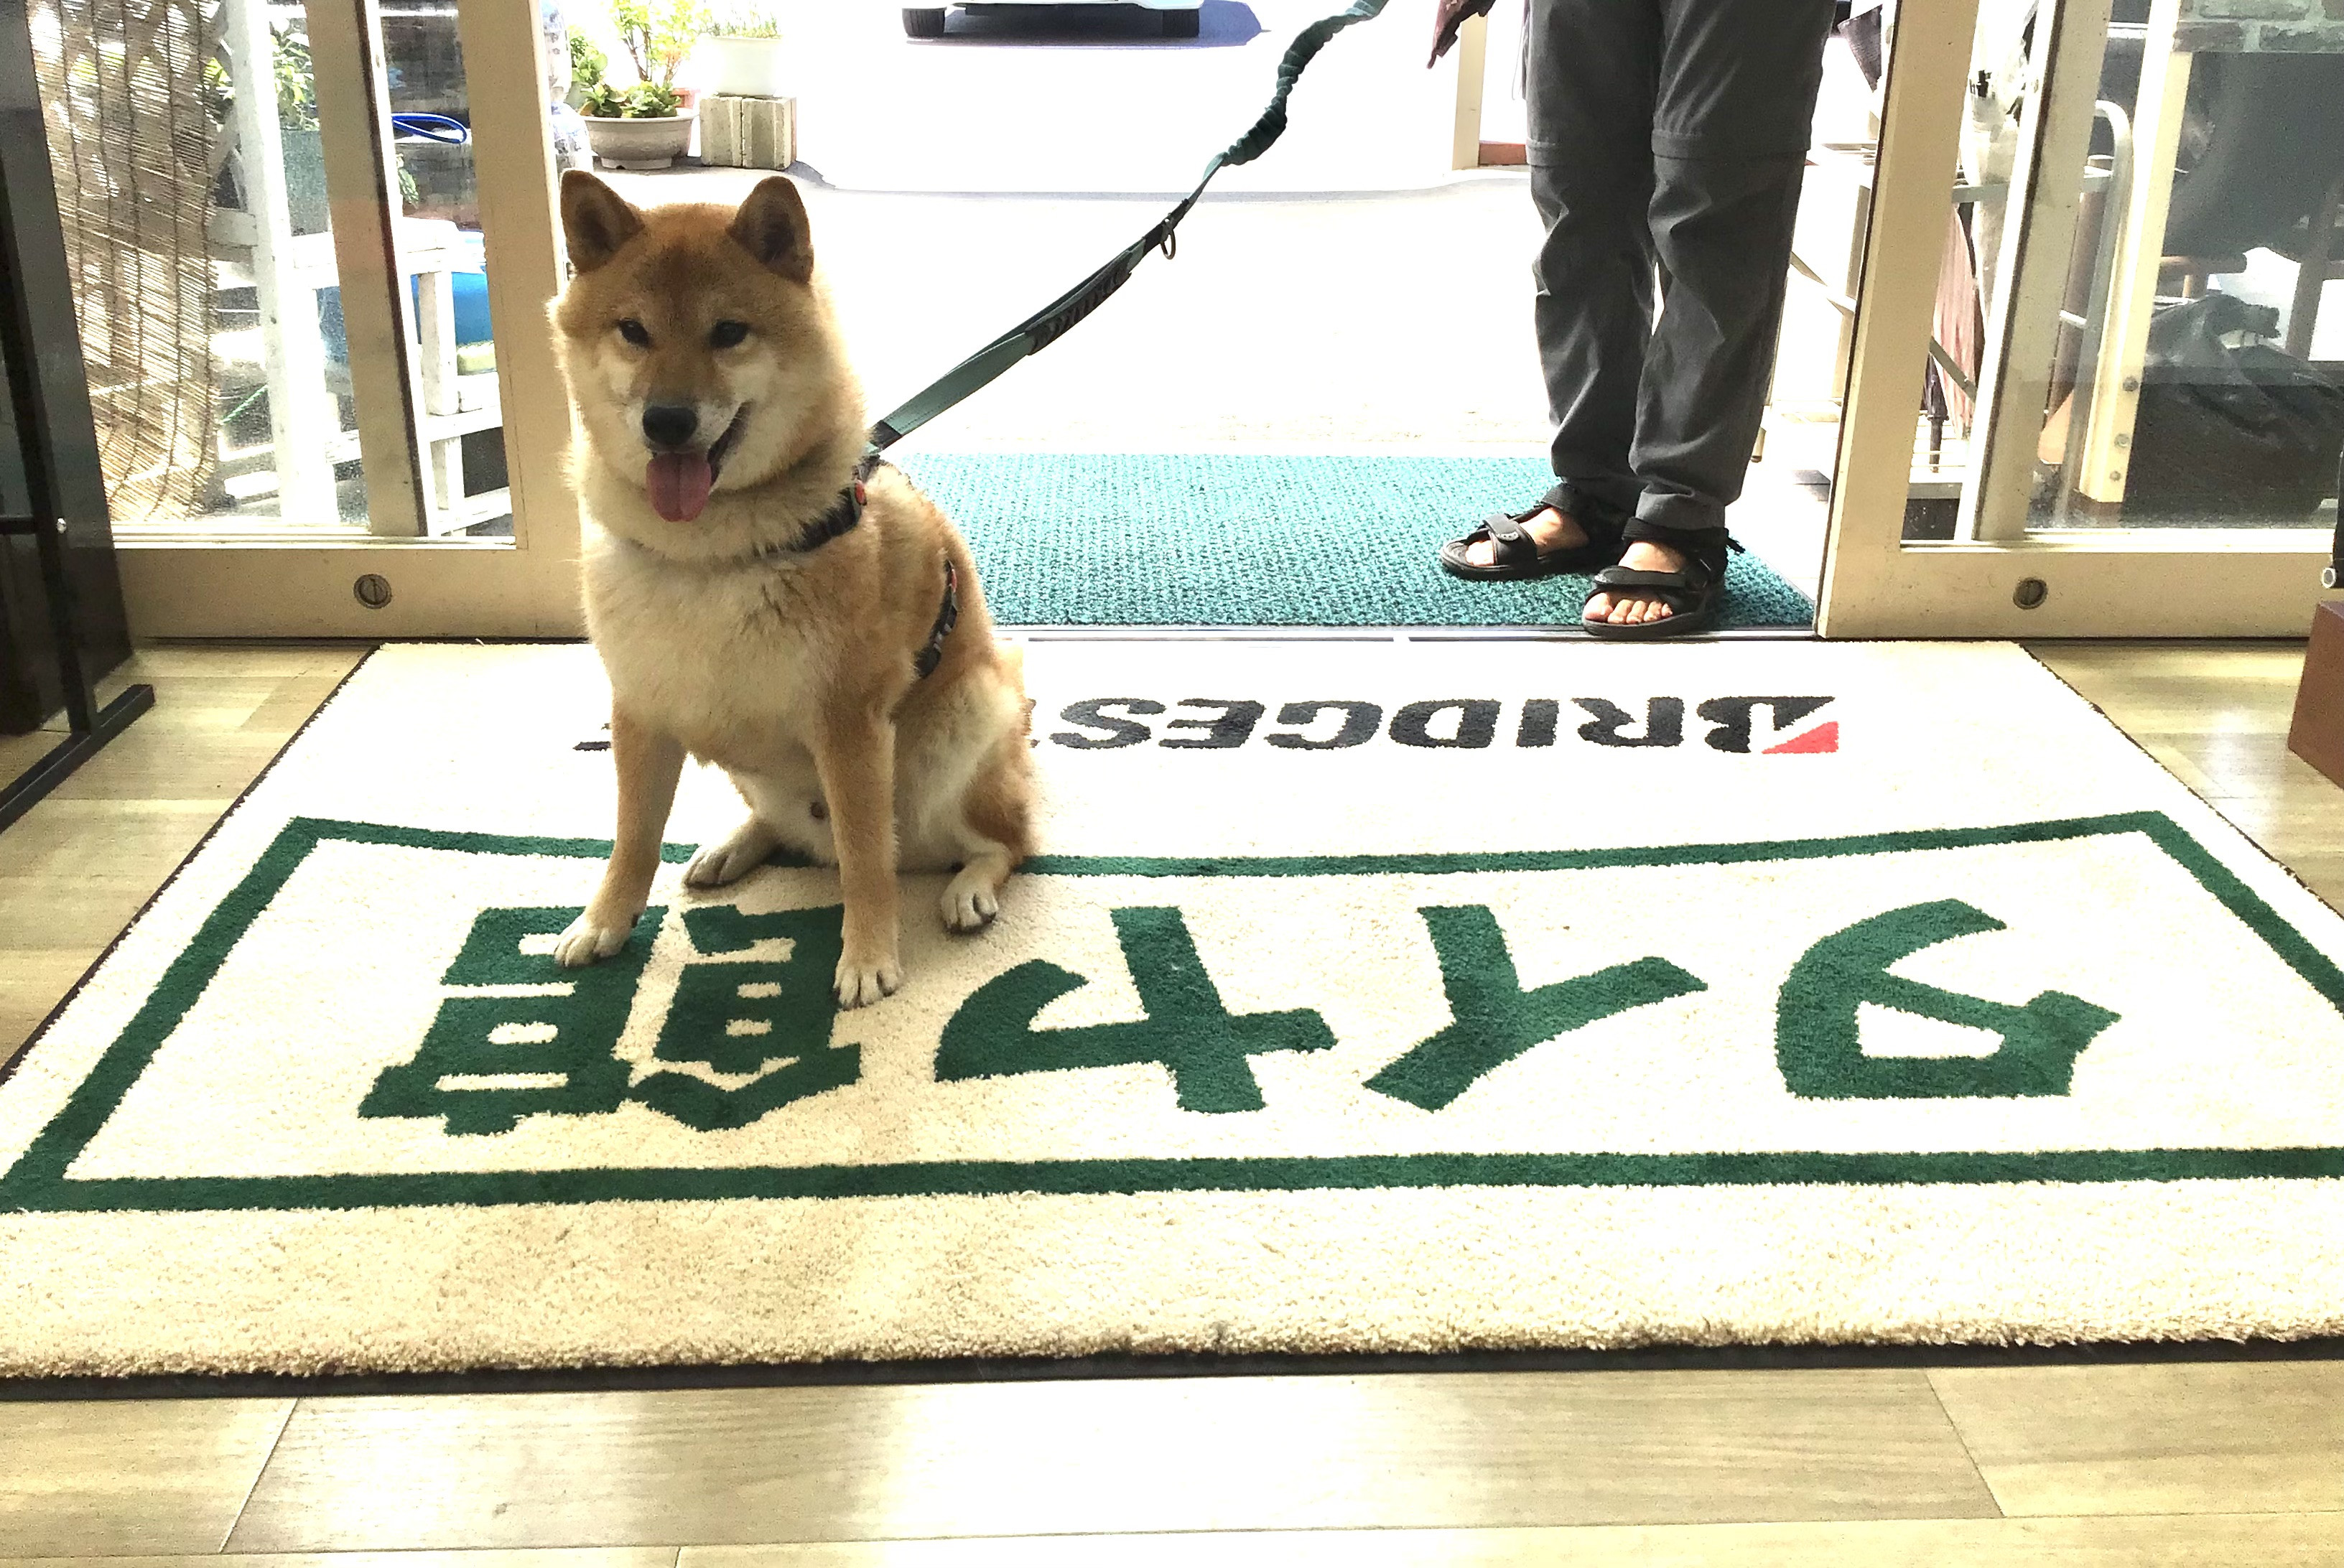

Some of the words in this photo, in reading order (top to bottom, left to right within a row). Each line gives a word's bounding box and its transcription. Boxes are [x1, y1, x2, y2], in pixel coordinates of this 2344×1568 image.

[574, 696, 1838, 754] BRIDGES
[359, 900, 2121, 1134] タイヤ館
